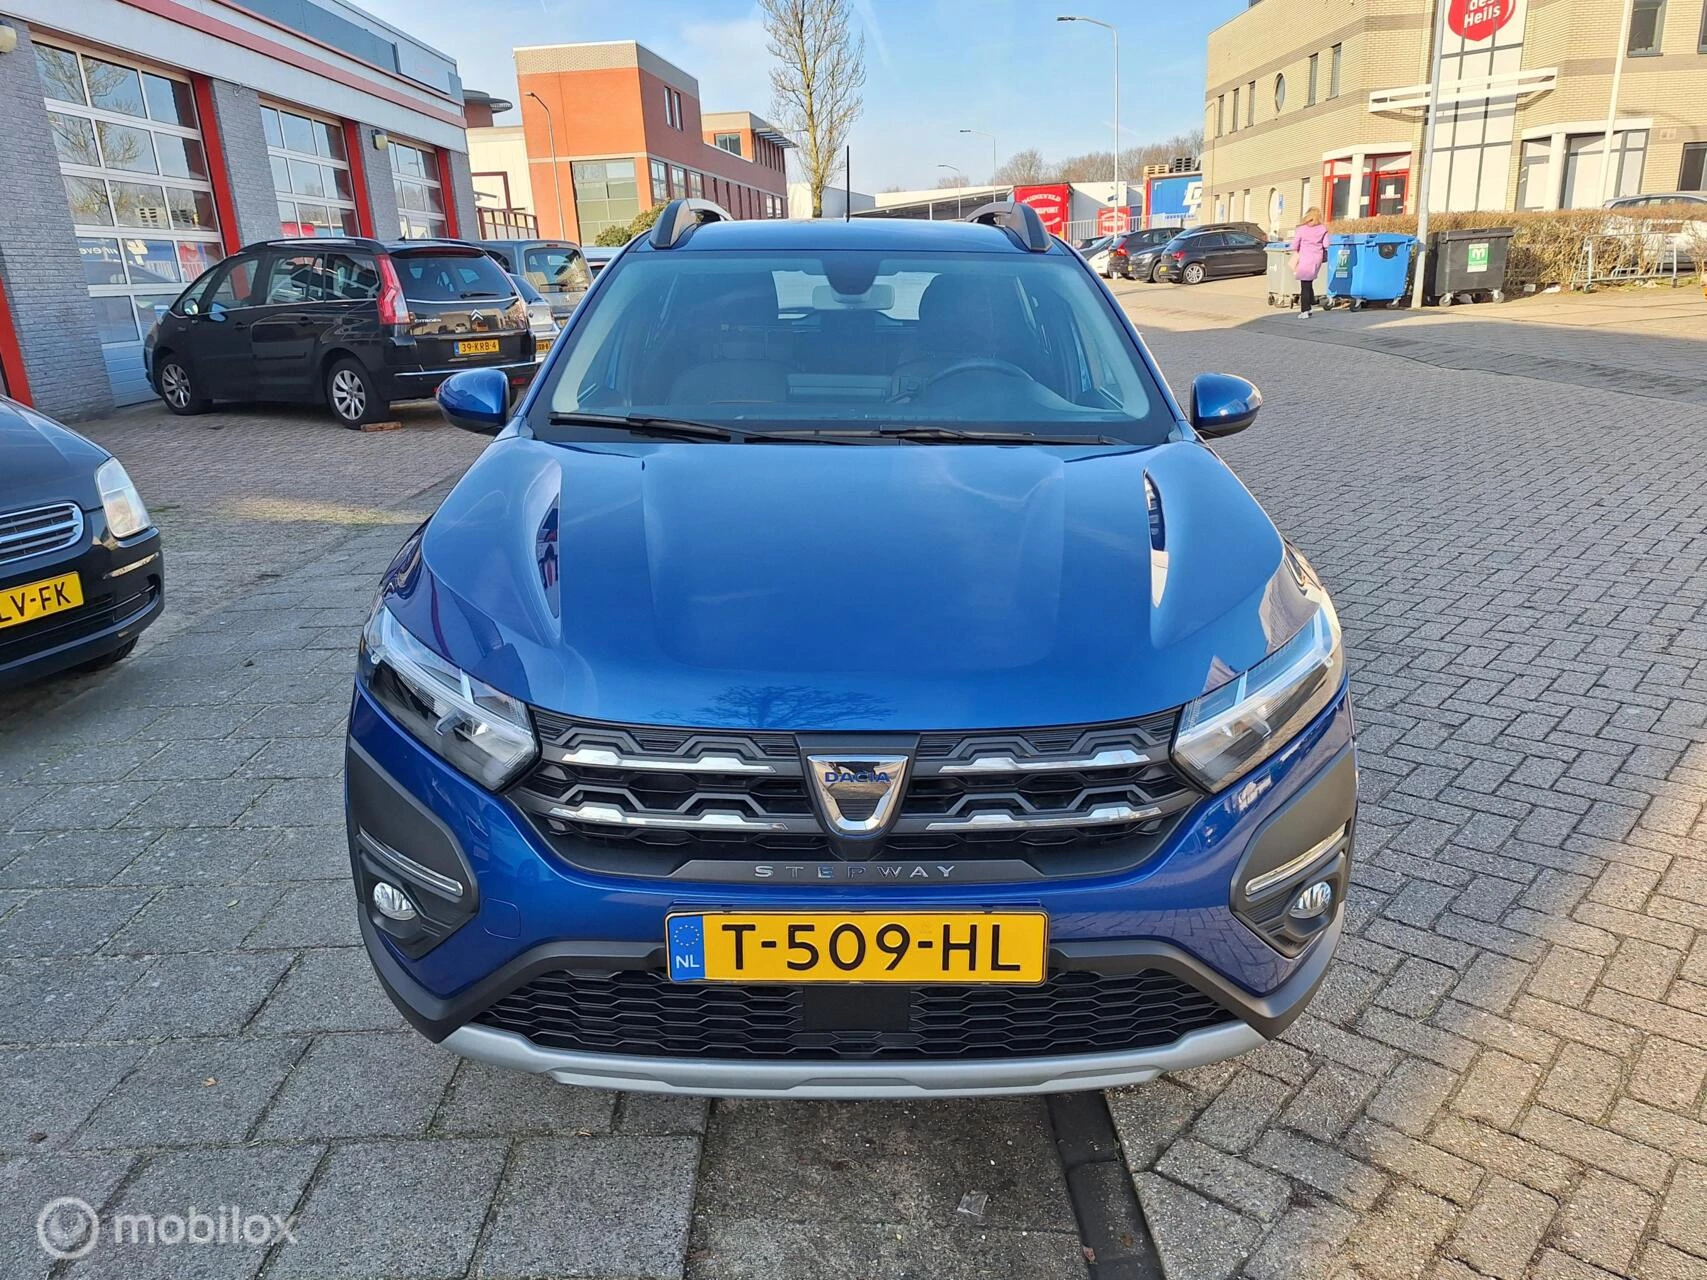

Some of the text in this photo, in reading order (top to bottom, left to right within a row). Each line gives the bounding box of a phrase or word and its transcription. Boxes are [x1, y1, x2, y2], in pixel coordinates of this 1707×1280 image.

[1464, 5, 1501, 28] Heils
[461, 341, 497, 353] 39-KRB-4
[824, 771, 890, 783] DACIA
[754, 865, 955, 879] STEPWAY
[721, 922, 1021, 971] T-509-HL
[675, 954, 700, 968] NL
